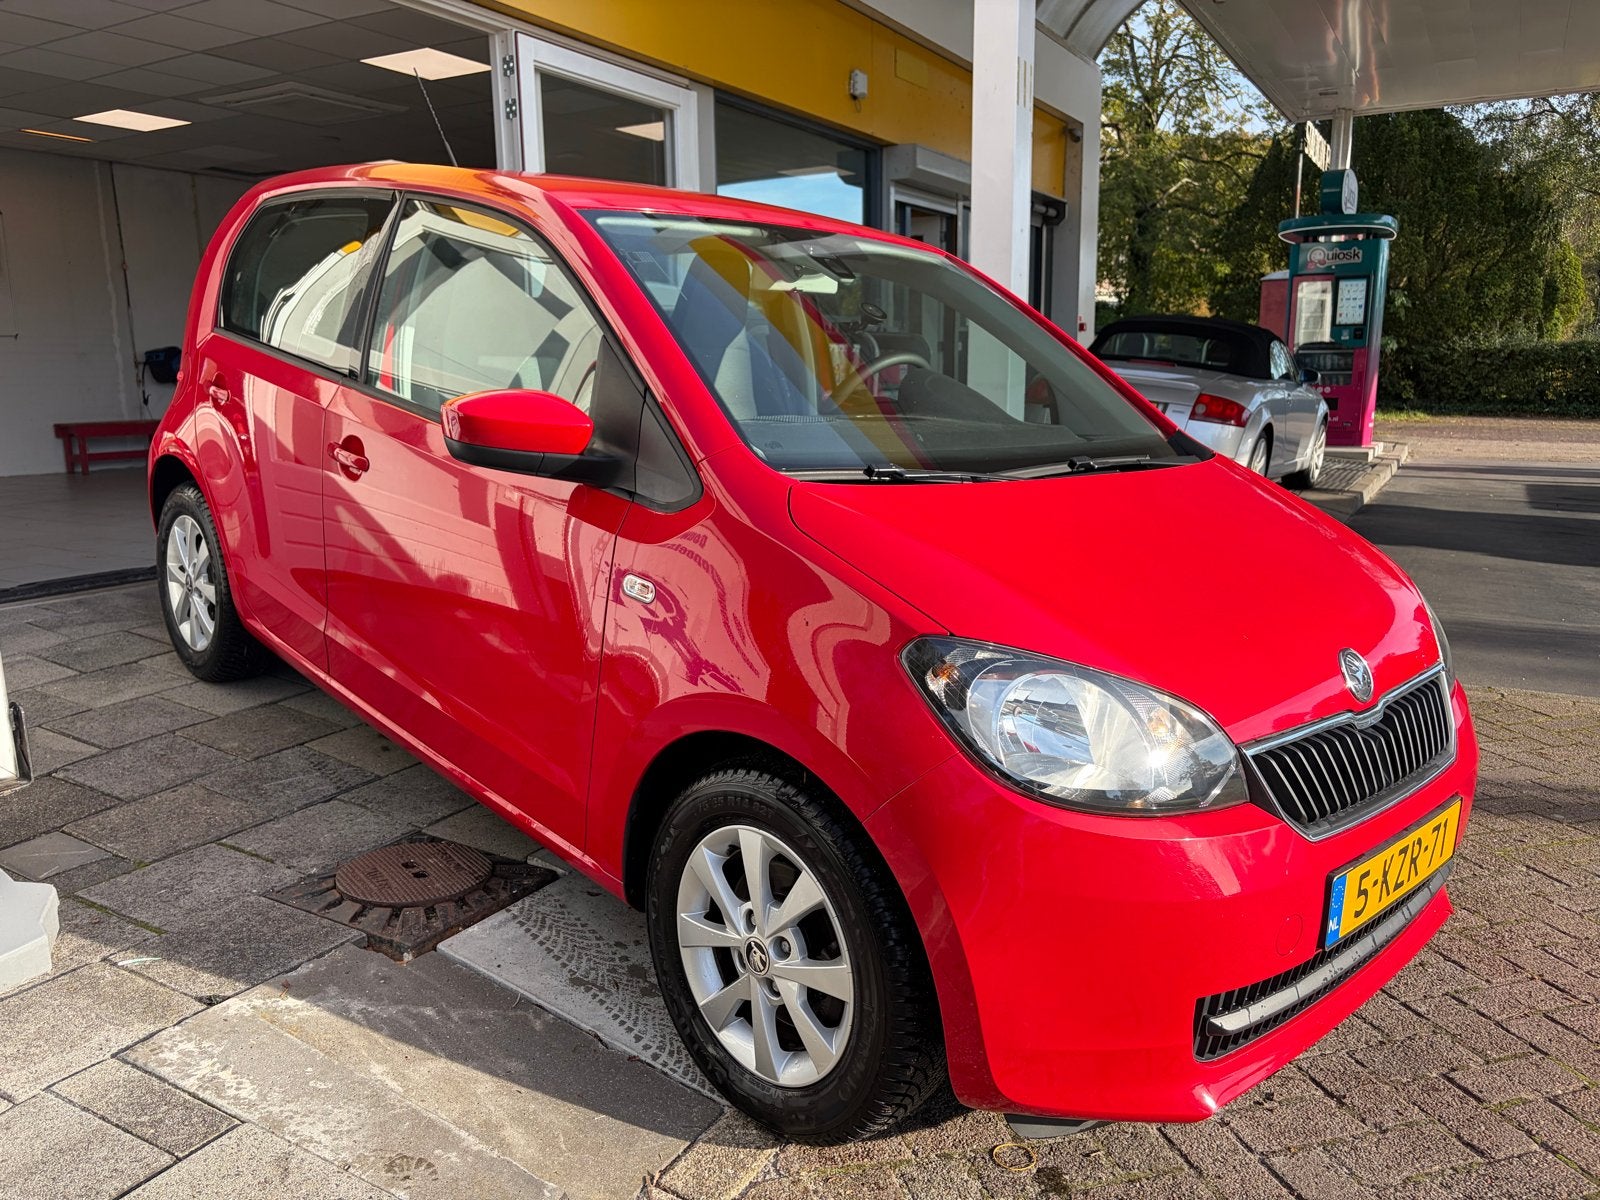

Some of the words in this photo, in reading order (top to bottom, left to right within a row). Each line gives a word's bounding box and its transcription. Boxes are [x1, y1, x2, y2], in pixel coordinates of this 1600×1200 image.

[1308, 246, 1361, 268] Quiosk
[1353, 817, 1449, 919] 5-KZR-71
[1328, 915, 1339, 933] NL
